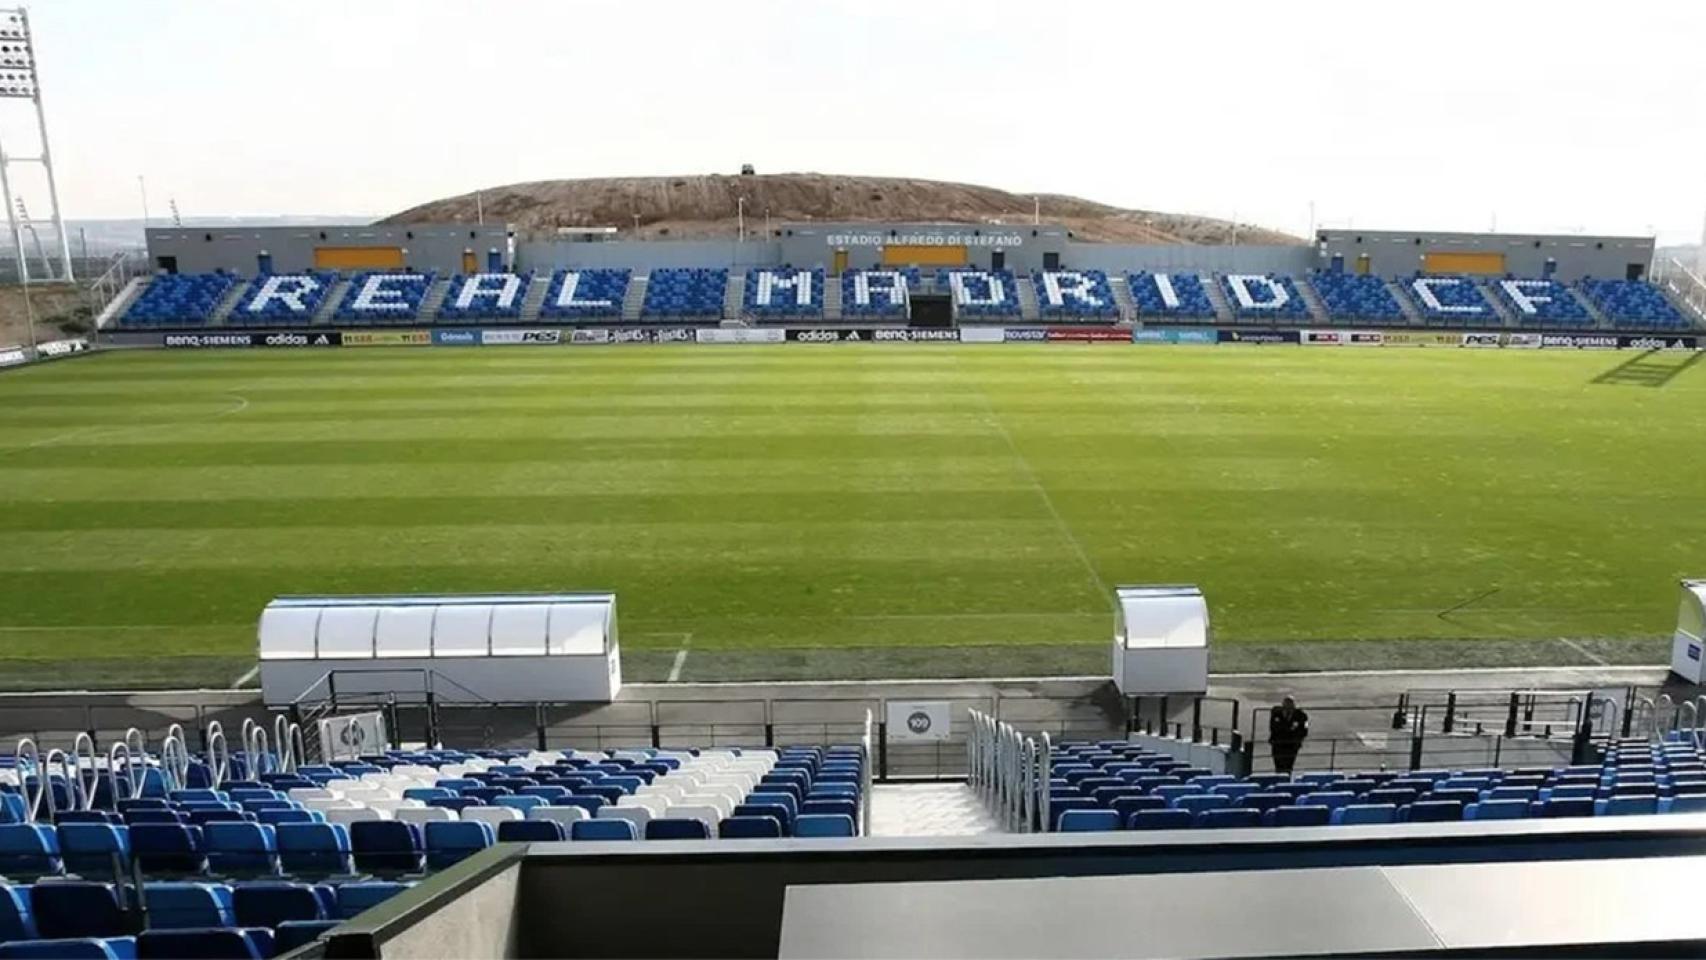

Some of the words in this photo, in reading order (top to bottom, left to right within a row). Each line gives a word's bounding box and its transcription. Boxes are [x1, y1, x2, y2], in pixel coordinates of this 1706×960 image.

[827, 235, 881, 245] ESTADIO
[886, 235, 943, 245] ALFREDO
[948, 235, 961, 246] DI
[965, 235, 1022, 246] STEFANO
[248, 273, 612, 311] REAL
[756, 270, 1288, 309] MADRID
[1412, 278, 1551, 314] CF
[266, 334, 308, 345] adidas
[522, 332, 557, 342] PES
[797, 330, 839, 342] adidas
[1466, 335, 1498, 345] PES
[1630, 337, 1667, 348] adidas
